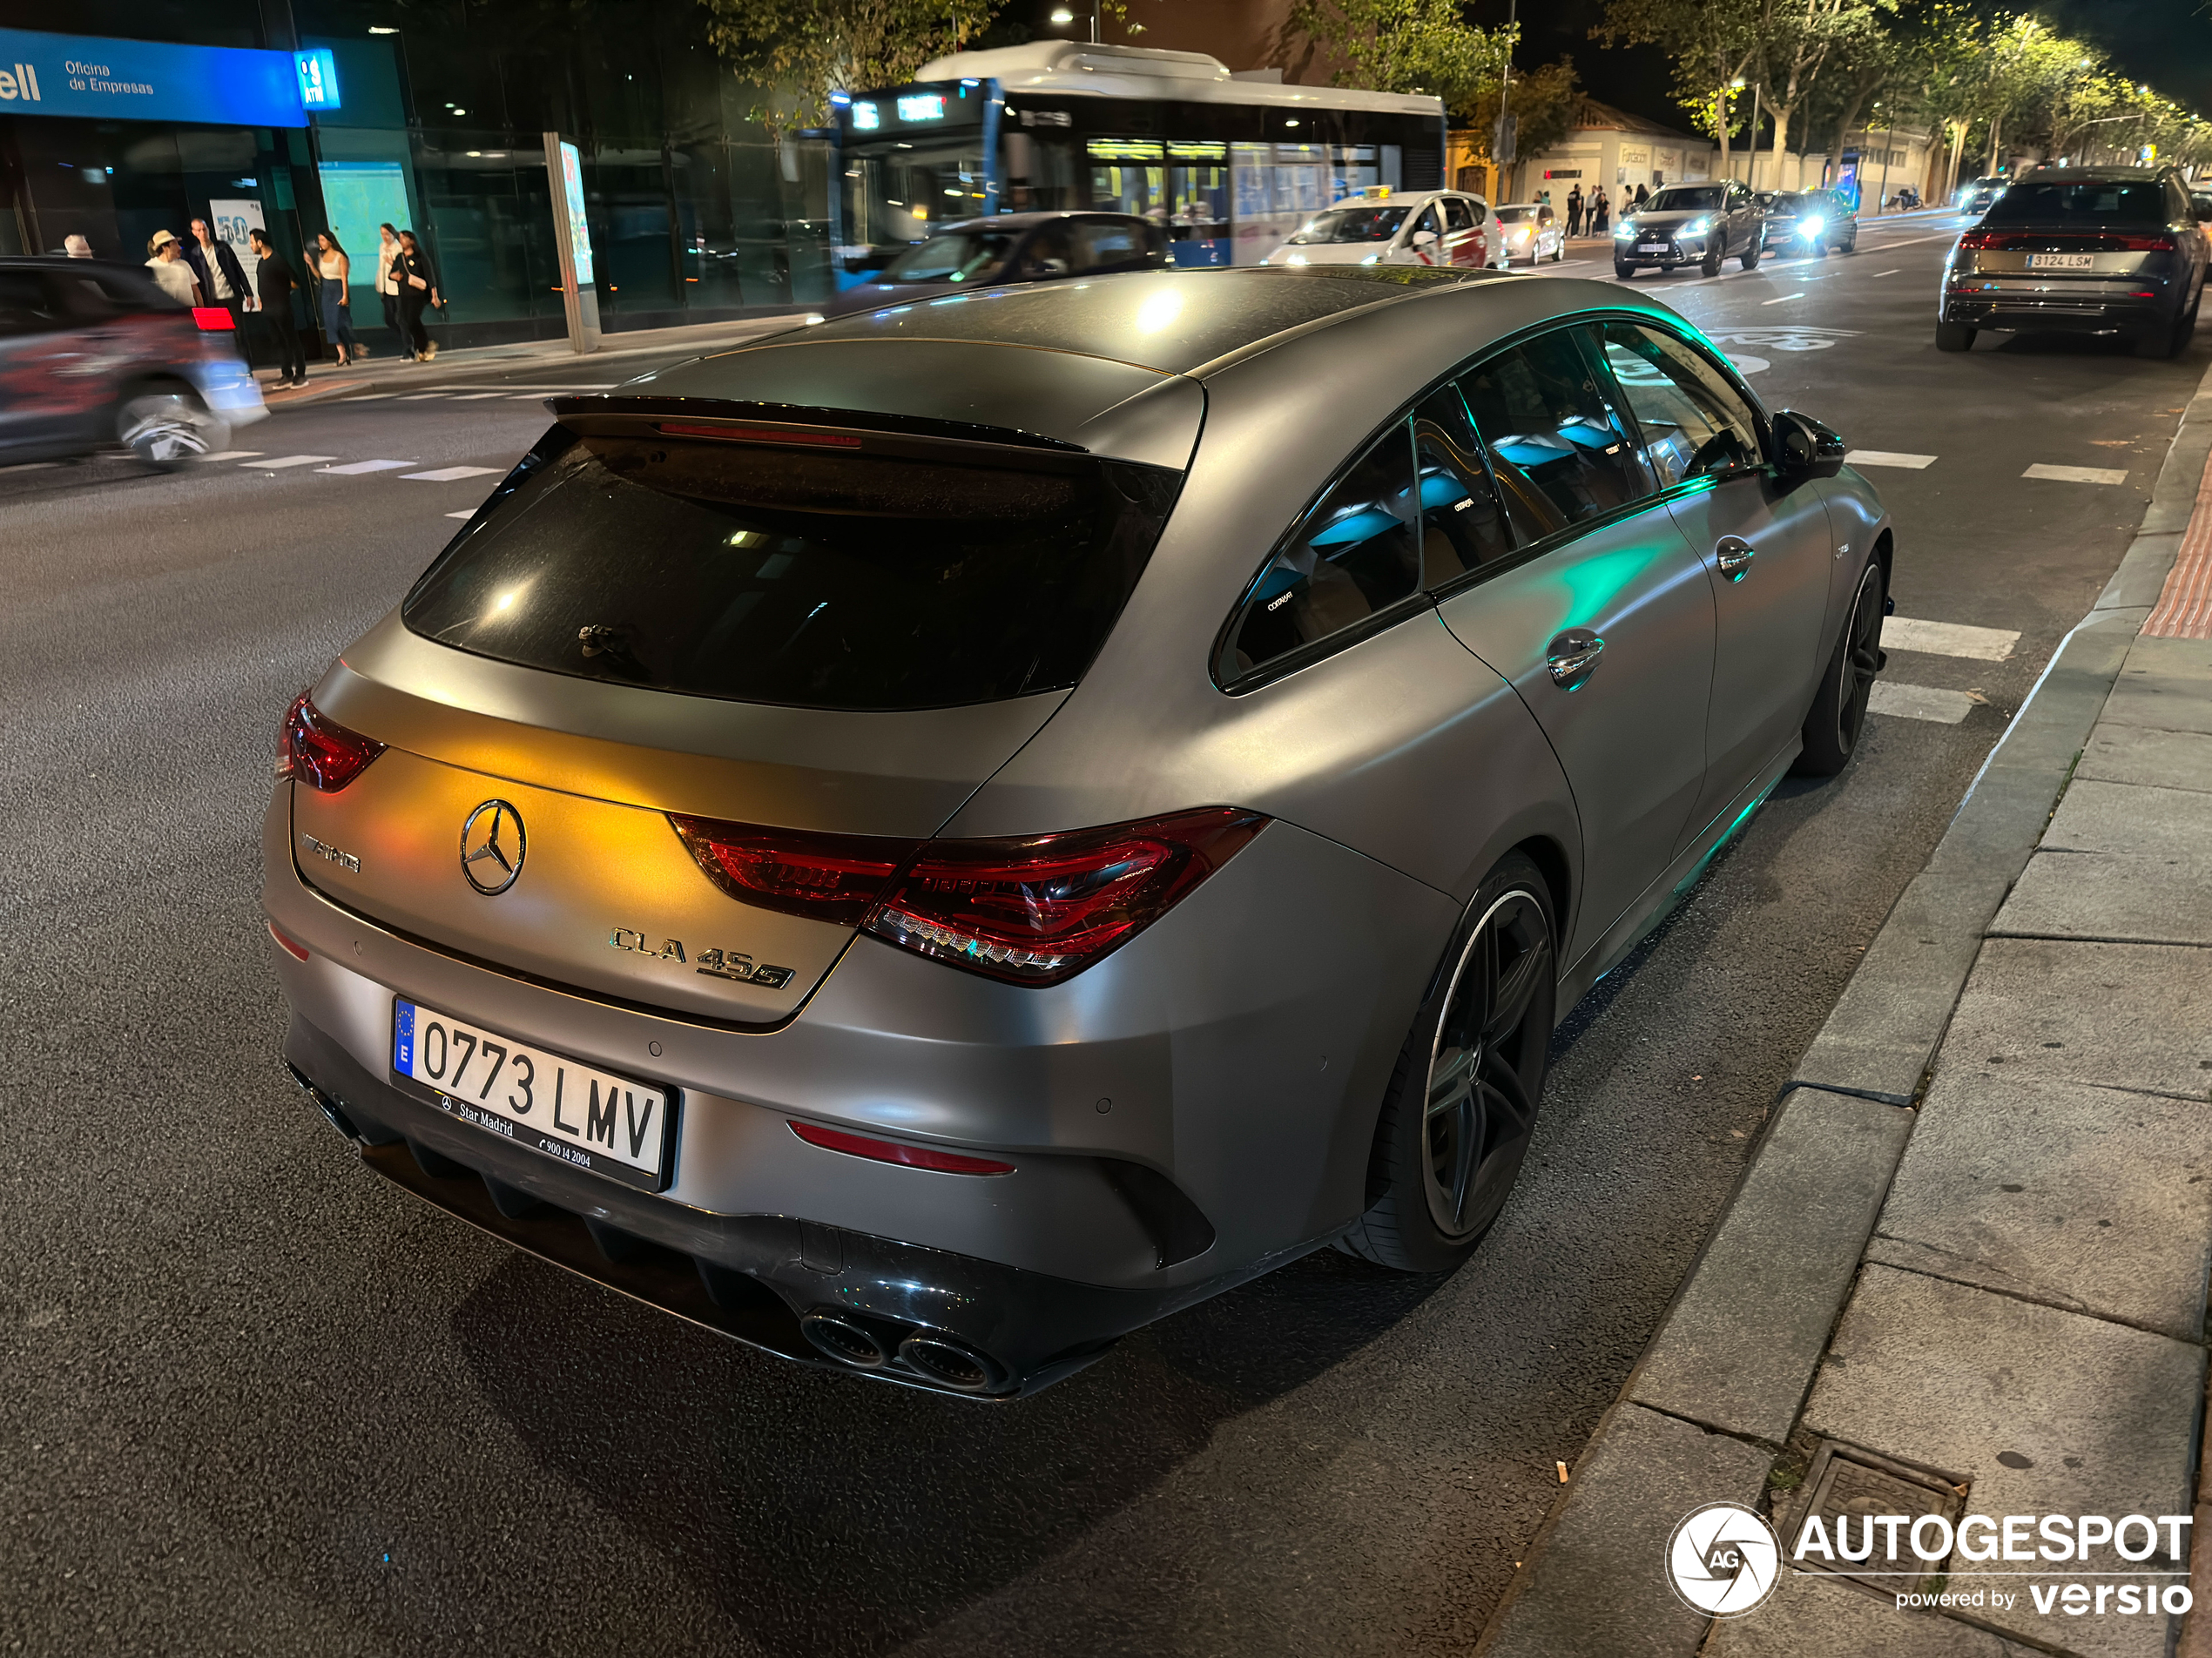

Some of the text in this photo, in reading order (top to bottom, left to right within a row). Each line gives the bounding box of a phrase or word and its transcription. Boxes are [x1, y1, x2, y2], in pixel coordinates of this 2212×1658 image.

[65, 60, 111, 77] Oficina
[69, 78, 154, 95] de Empresas
[305, 85, 324, 104] ATM
[217, 215, 249, 245] 50
[2034, 255, 2092, 266] 3124 LSM
[610, 927, 686, 963] CLA
[401, 1044, 408, 1062] E
[424, 1021, 654, 1159] 0773 LMV
[460, 1103, 514, 1137] Star Madrid
[546, 1141, 590, 1167] 900 14 2004
